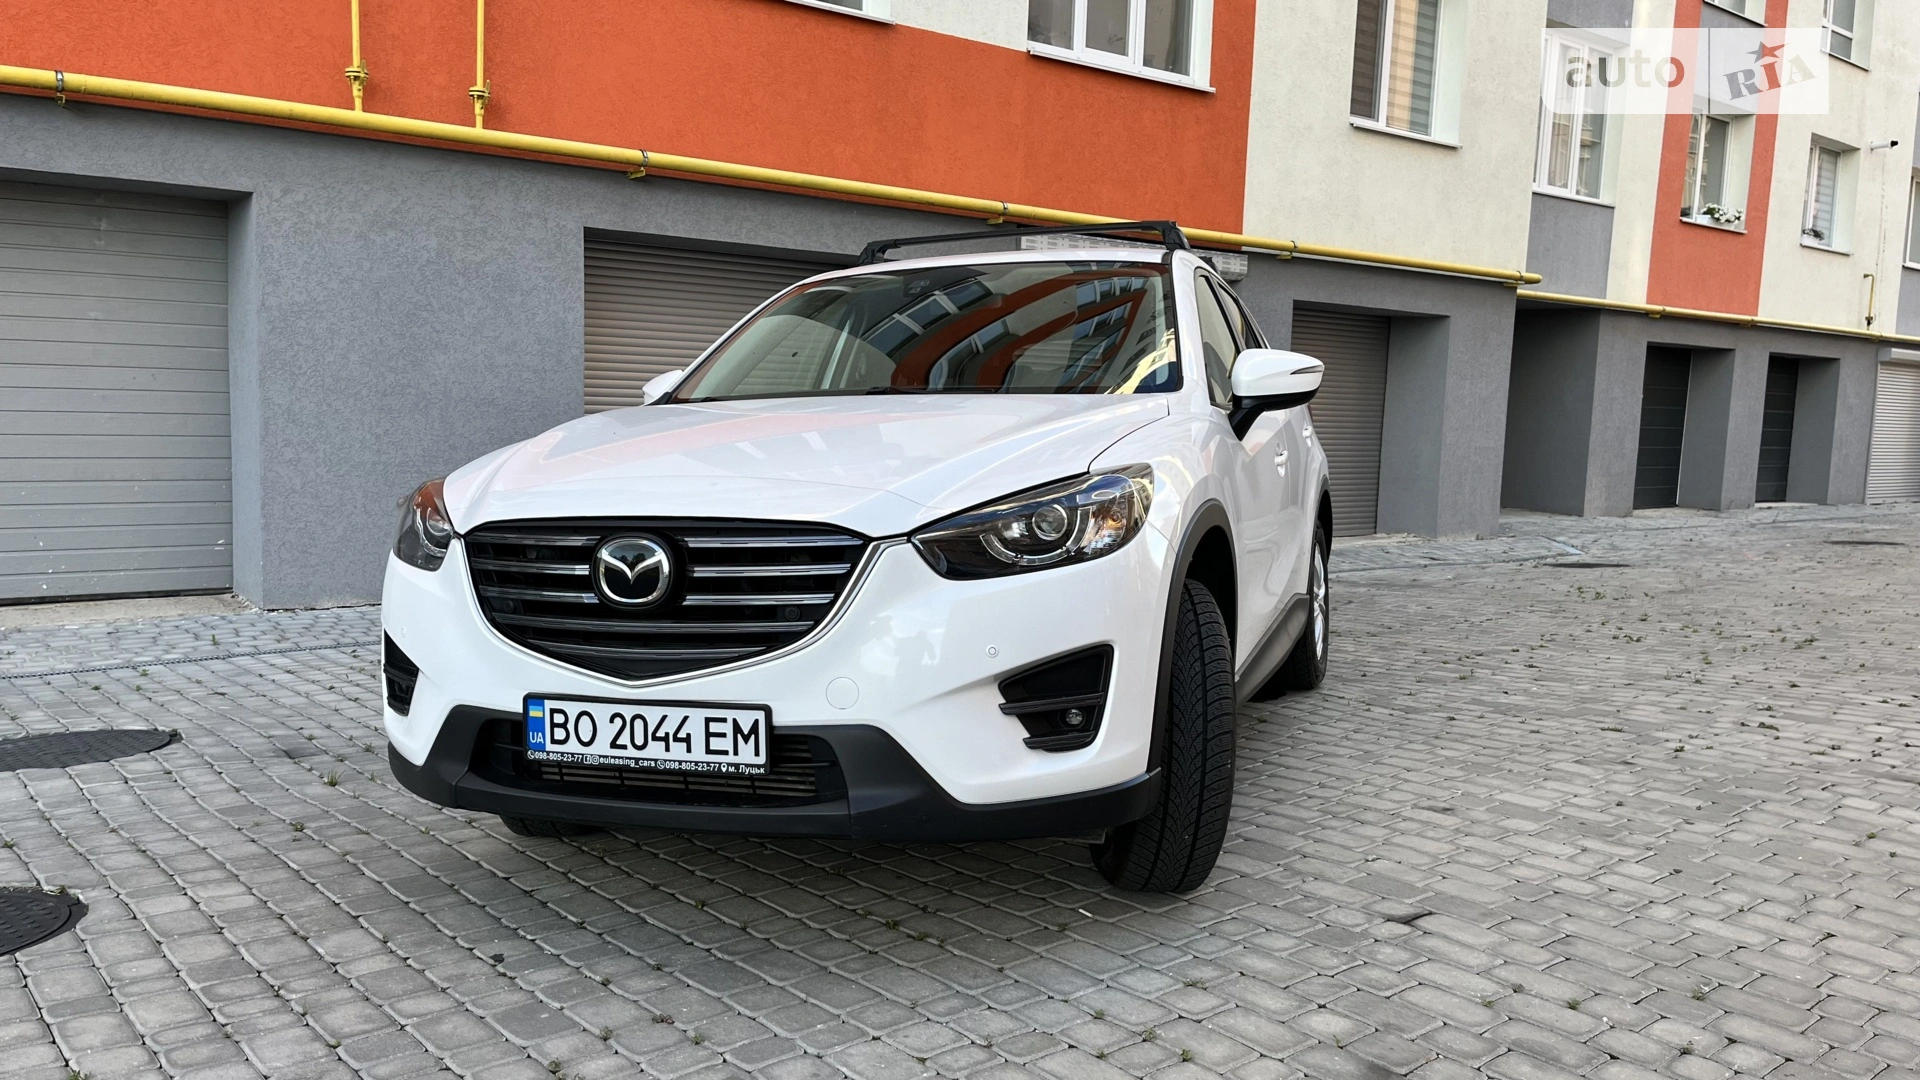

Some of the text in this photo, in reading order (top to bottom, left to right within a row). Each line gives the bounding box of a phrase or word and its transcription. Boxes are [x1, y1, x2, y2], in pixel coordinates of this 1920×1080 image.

[529, 731, 544, 744] UA
[549, 707, 760, 757] BO 2044 EM
[535, 751, 582, 763] 098-805-23-77
[599, 757, 656, 768] euleasing_cars
[665, 761, 719, 772] 098-805-23-77
[738, 765, 766, 775] Луцьк
